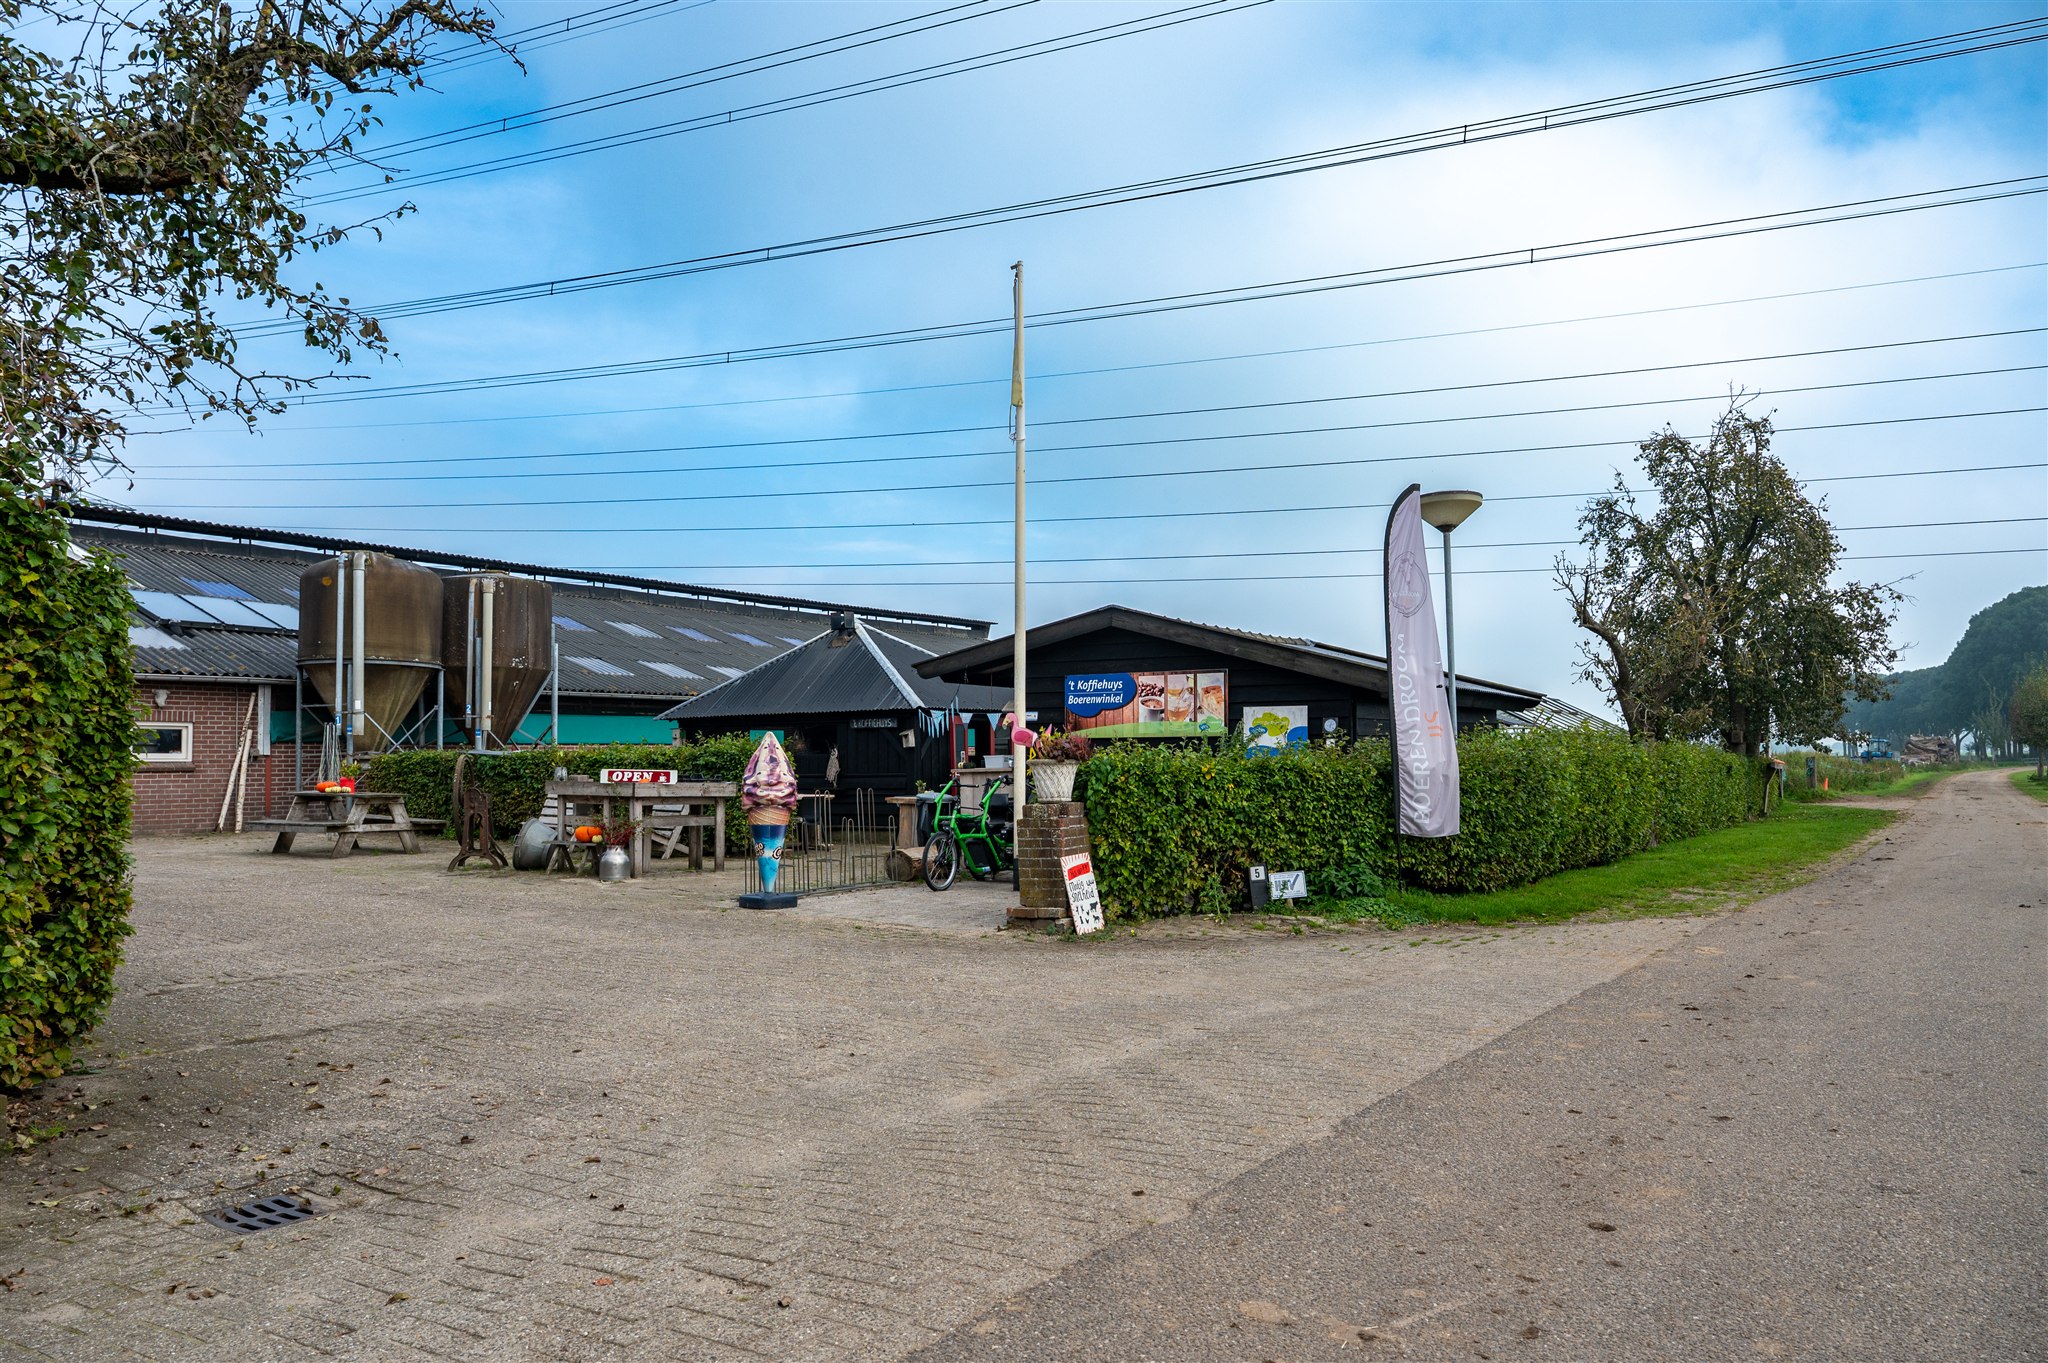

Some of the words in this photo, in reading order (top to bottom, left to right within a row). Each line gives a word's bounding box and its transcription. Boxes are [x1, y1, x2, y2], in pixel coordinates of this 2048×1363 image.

[1397, 633, 1421, 722] DROOM
[1077, 679, 1123, 692] Koffiehuys
[1068, 693, 1123, 705] Boerenwinkel
[612, 771, 653, 782] OPEN
[1409, 730, 1432, 825] BOEREN
[1254, 868, 1260, 878] 5
